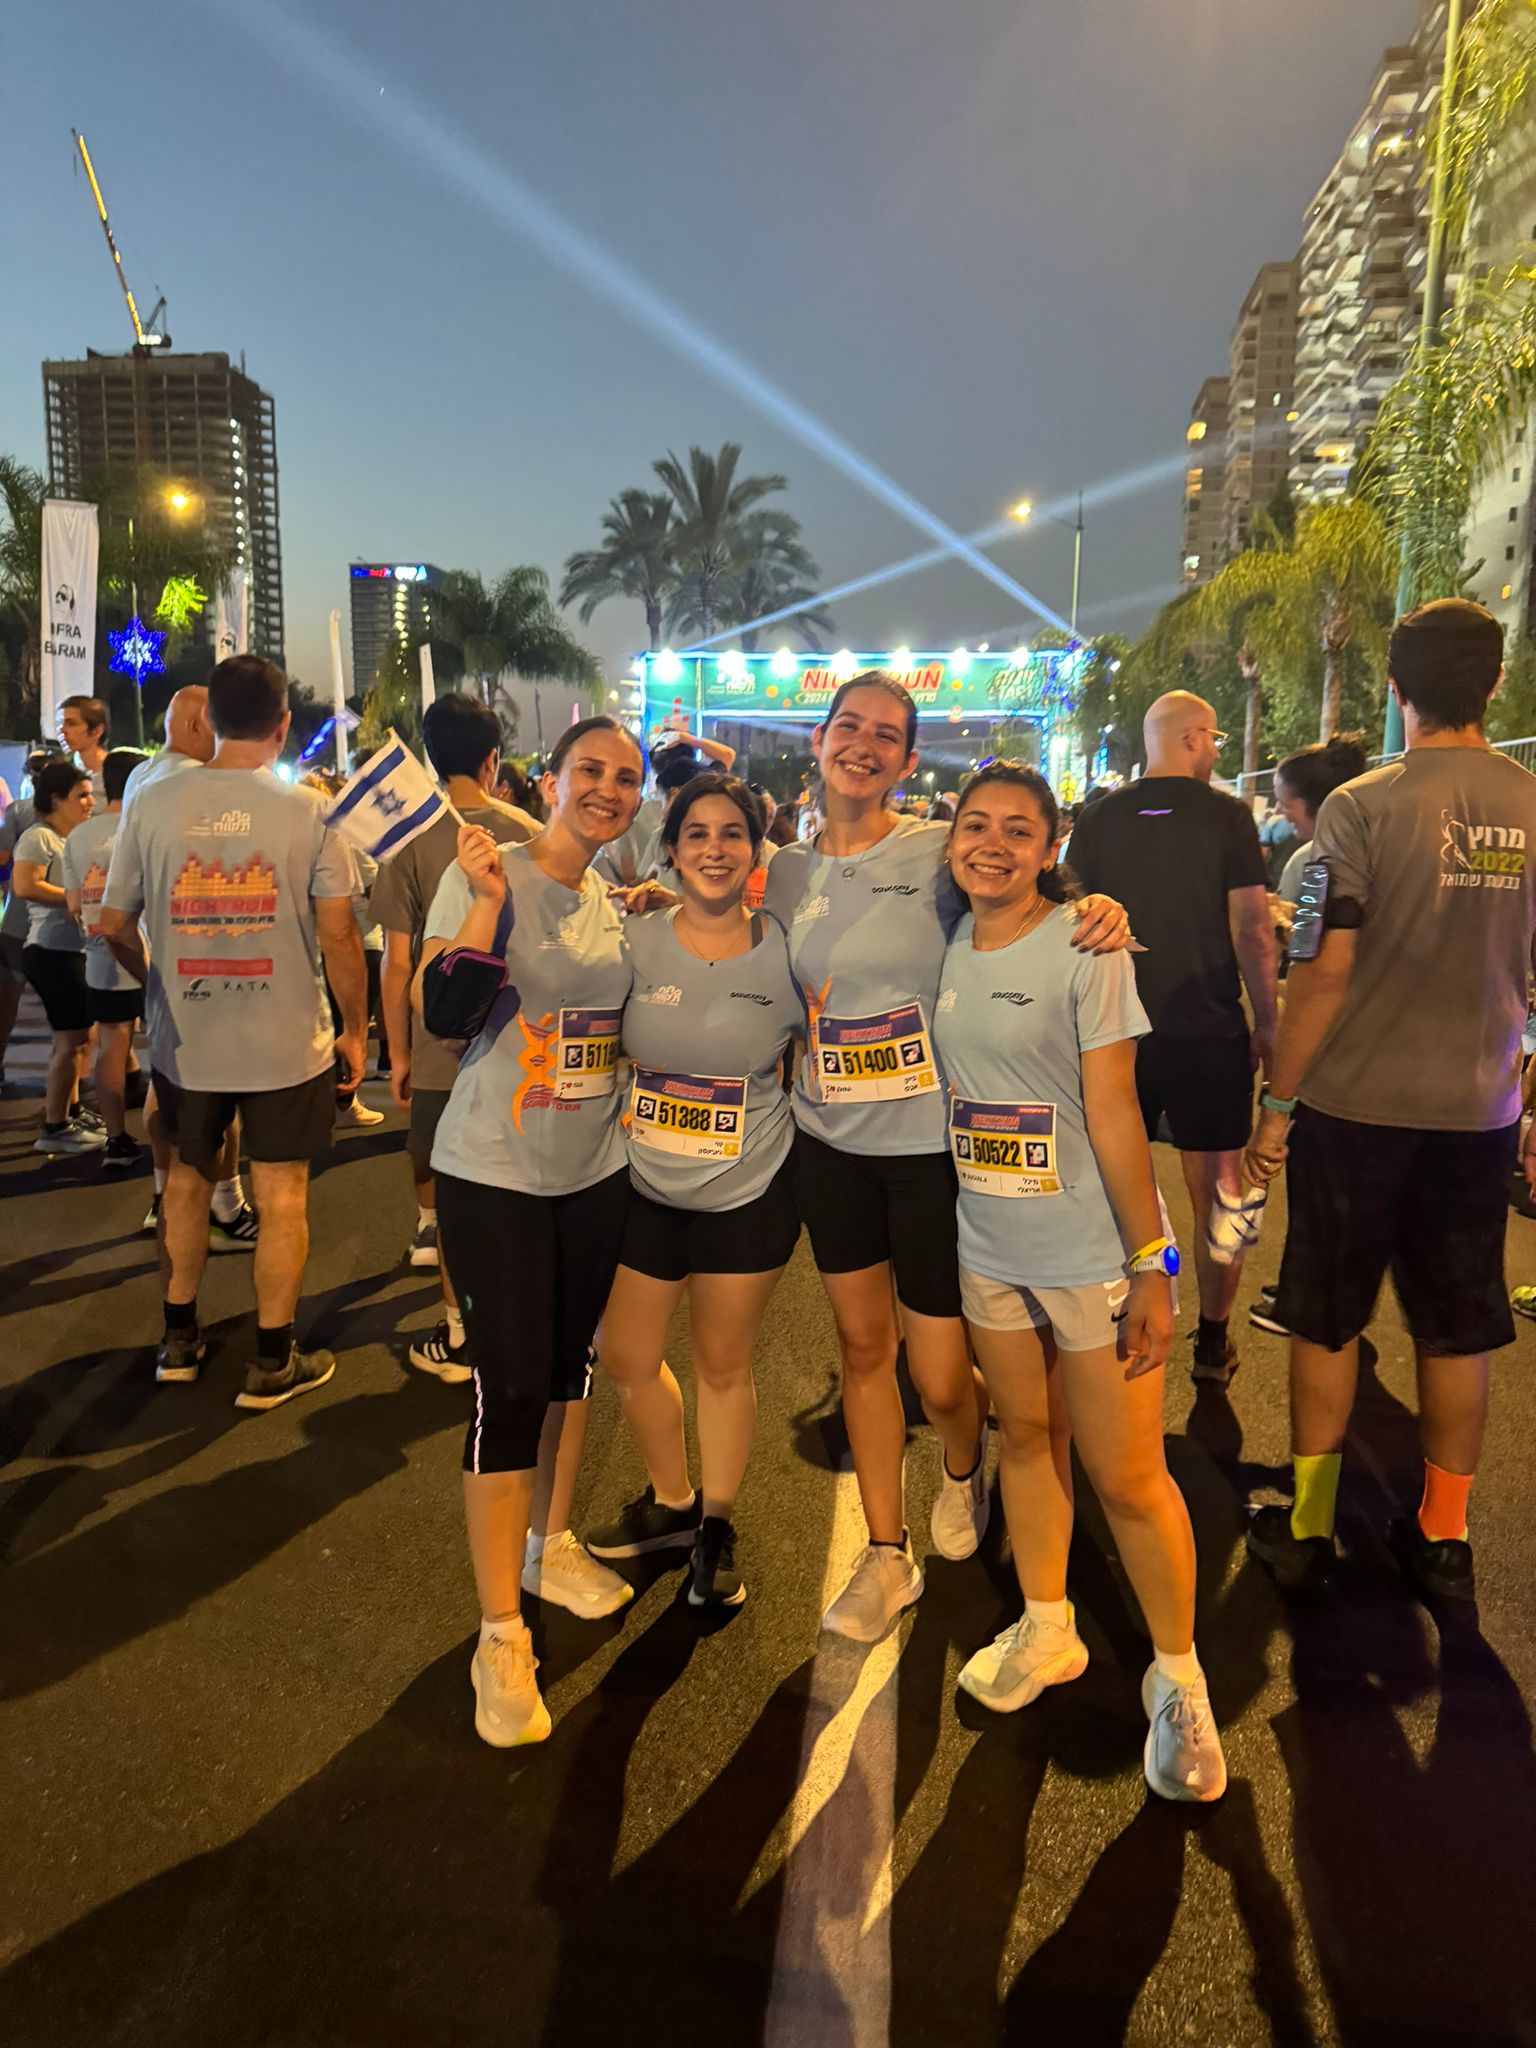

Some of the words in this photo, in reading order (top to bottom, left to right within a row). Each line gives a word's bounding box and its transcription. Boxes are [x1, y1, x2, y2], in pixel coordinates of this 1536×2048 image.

[1467, 825, 1526, 850] מרוץ
[1470, 850, 1526, 873] 2022
[842, 1046, 898, 1075] 51400
[658, 1101, 711, 1132] 51388
[973, 1137, 1022, 1167] 50522
